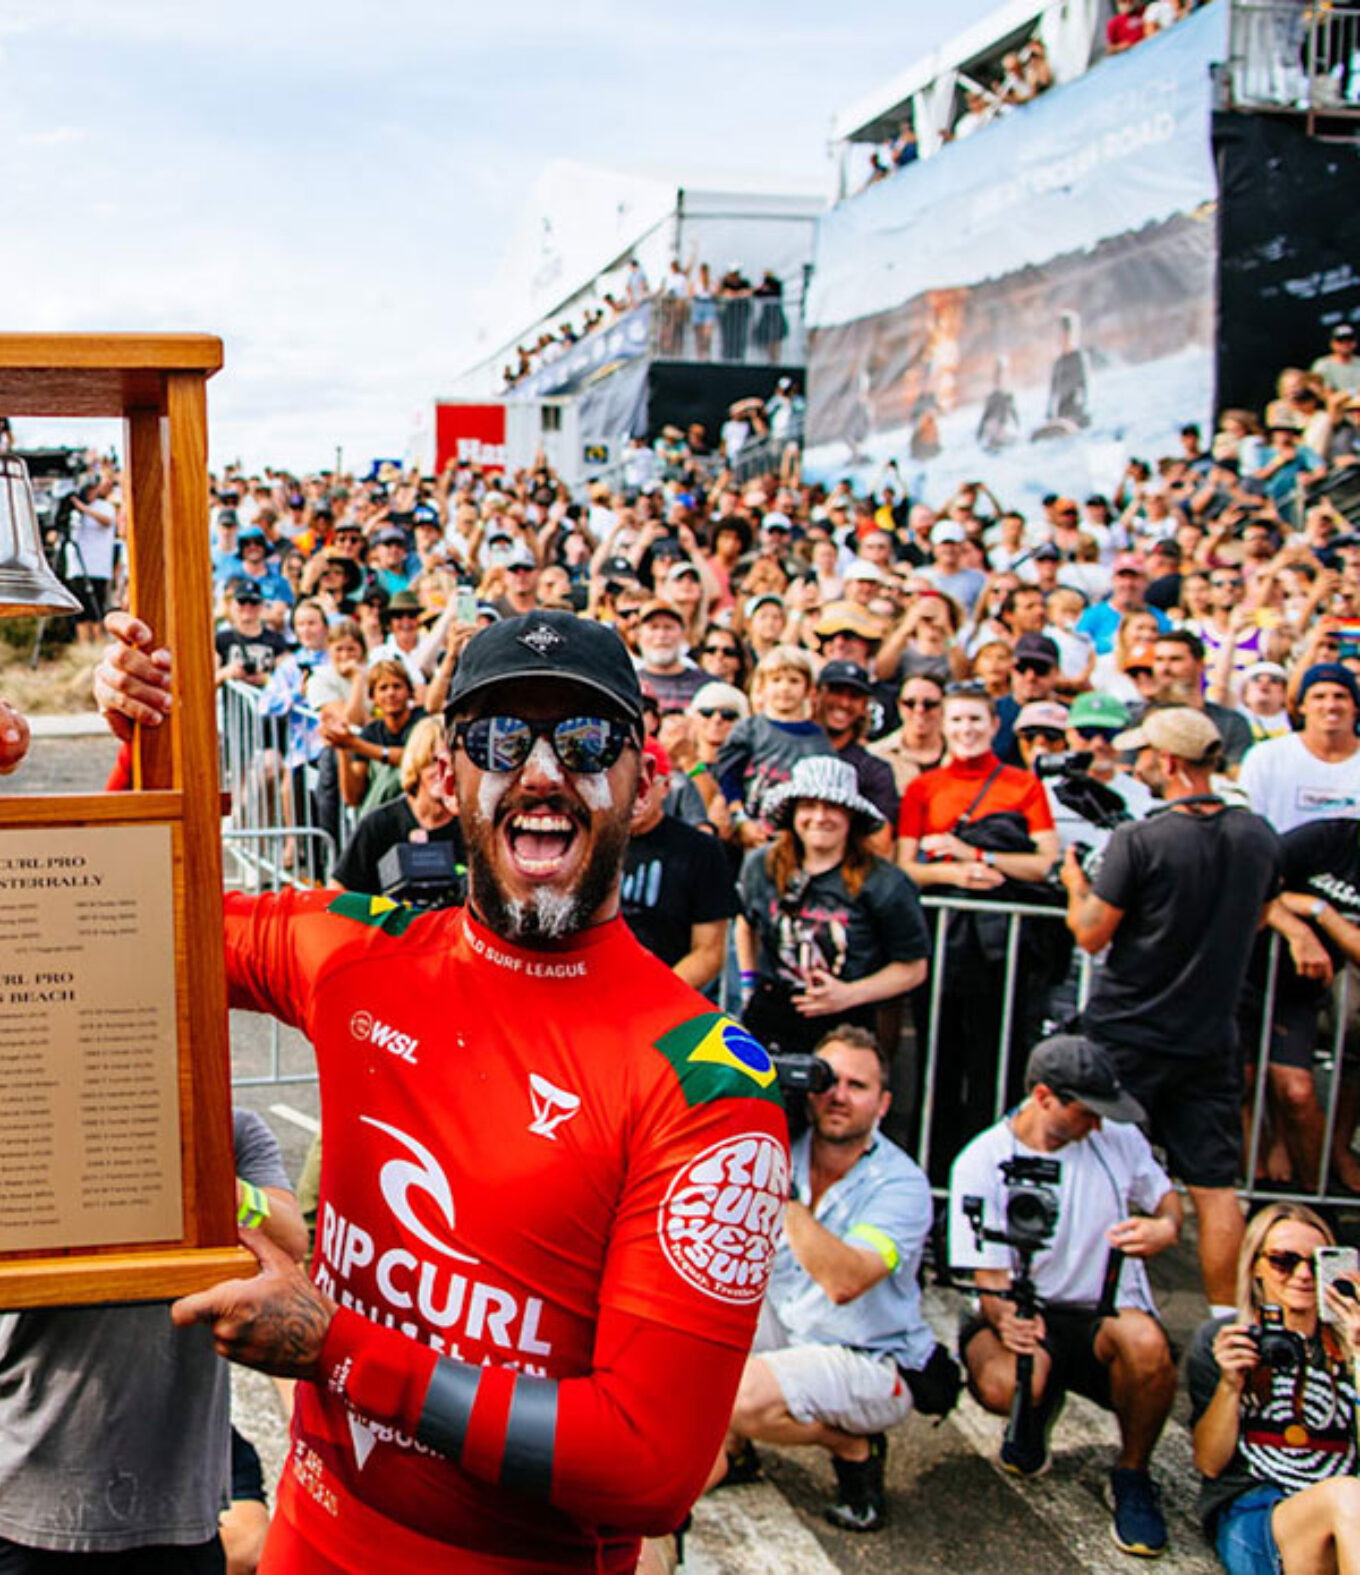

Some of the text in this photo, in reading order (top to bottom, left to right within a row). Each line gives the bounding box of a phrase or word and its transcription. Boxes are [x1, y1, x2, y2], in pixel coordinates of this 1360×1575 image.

[47, 856, 87, 868] PRO
[46, 875, 103, 889] RALLY
[485, 947, 587, 977] SURF LEAGUE
[35, 972, 74, 985] PRO
[10, 989, 76, 1005] BEACH
[371, 1020, 418, 1064] WSL
[689, 1139, 787, 1196] RIP
[322, 1201, 374, 1279] RIP
[376, 1248, 551, 1356] CURL
